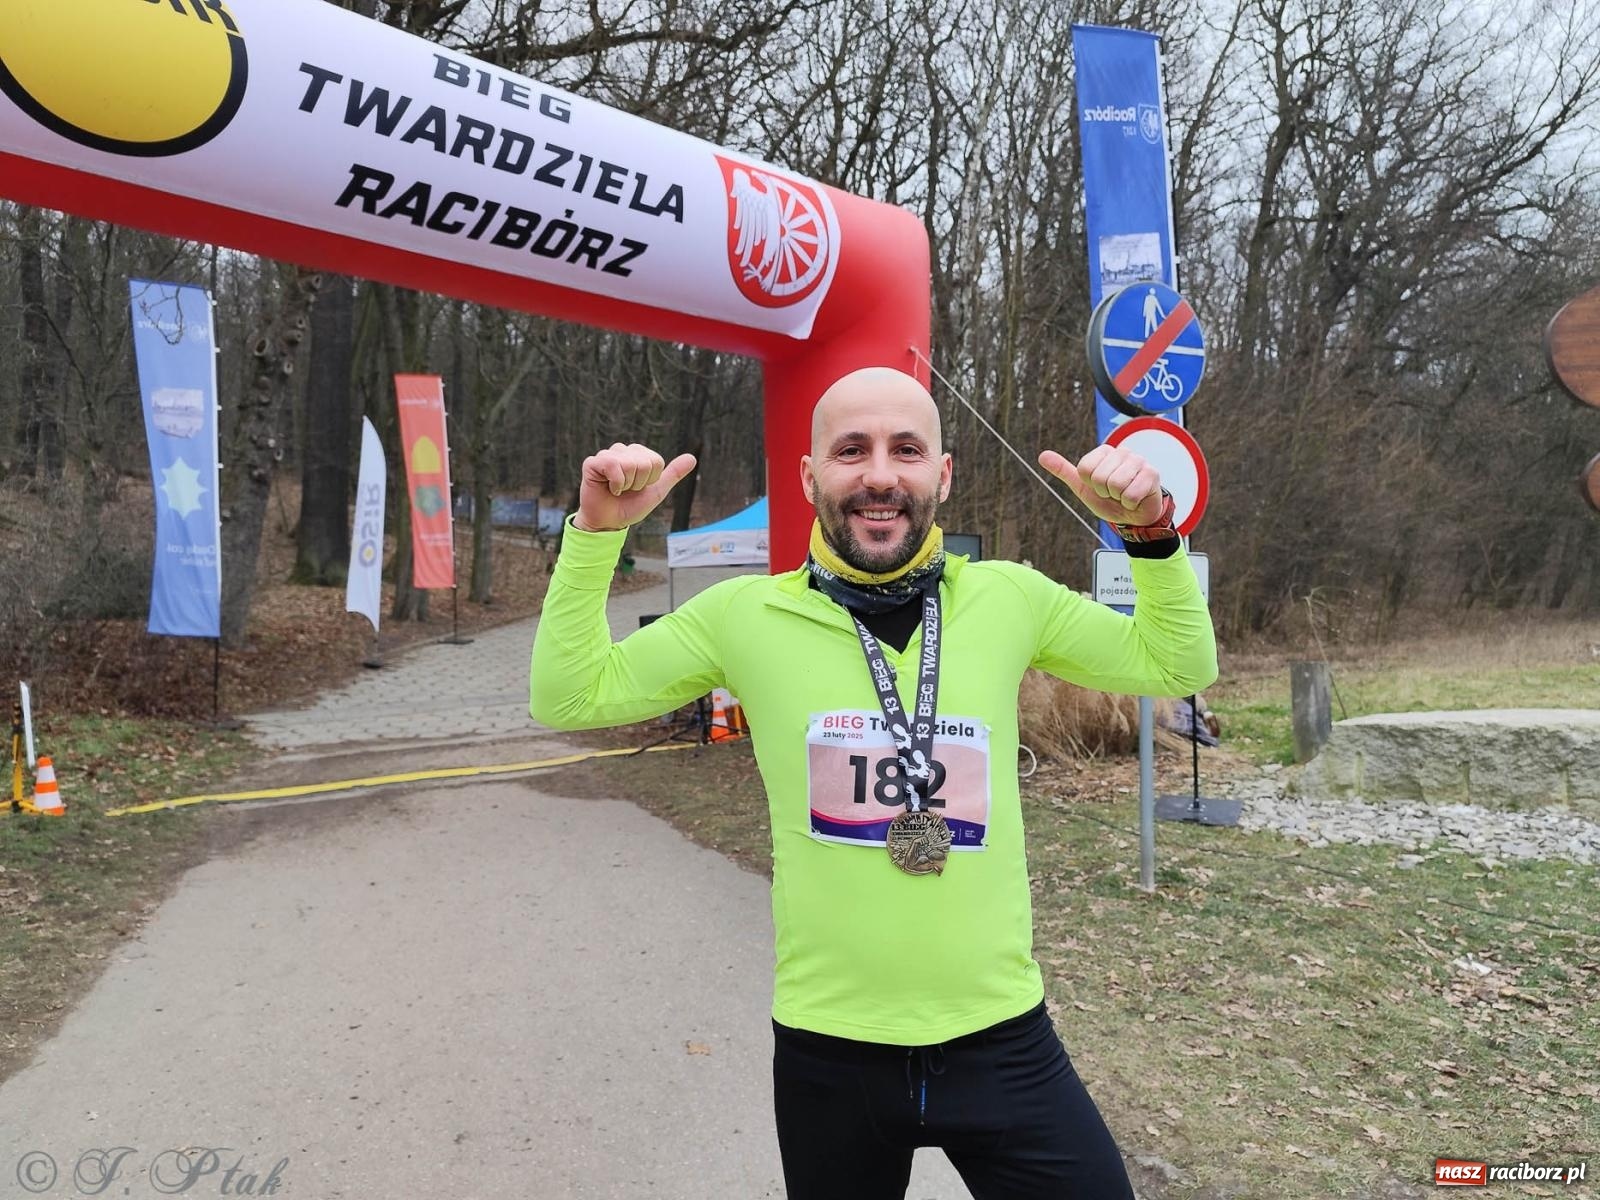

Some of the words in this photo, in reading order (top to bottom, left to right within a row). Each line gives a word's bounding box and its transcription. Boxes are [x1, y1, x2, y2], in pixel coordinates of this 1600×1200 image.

[433, 54, 571, 123] BIEG
[298, 62, 684, 224] TWARDZIELA
[335, 163, 649, 278] RACIBÓRZ
[922, 597, 939, 678] TWARDZIELA
[872, 658, 893, 692] BIEG
[884, 696, 900, 715] 13
[918, 683, 935, 717] BIEG
[823, 715, 864, 729] BIEG
[869, 717, 974, 737] Twziela
[832, 731, 846, 740] luty
[847, 732, 864, 740] 2025
[916, 722, 930, 740] 13
[849, 754, 946, 809] 182
